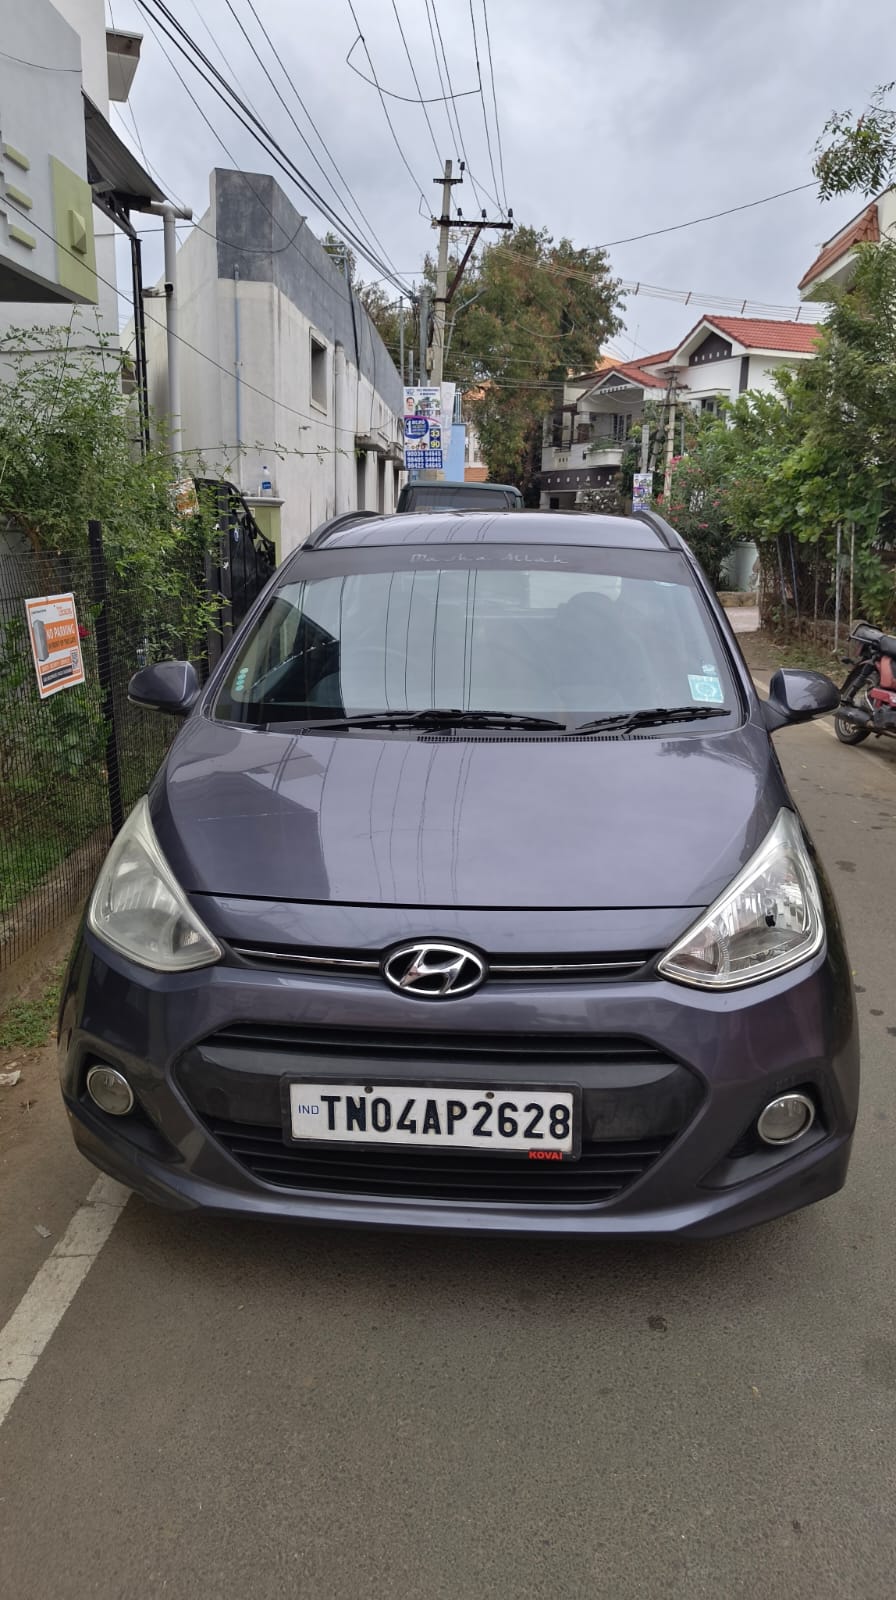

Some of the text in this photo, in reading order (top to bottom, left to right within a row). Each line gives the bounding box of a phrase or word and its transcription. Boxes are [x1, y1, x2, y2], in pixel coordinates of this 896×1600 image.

[46, 624, 76, 640] NO PARKING
[298, 1094, 570, 1140] IND TN04AP2628
[528, 1150, 563, 1161] KOVAI
